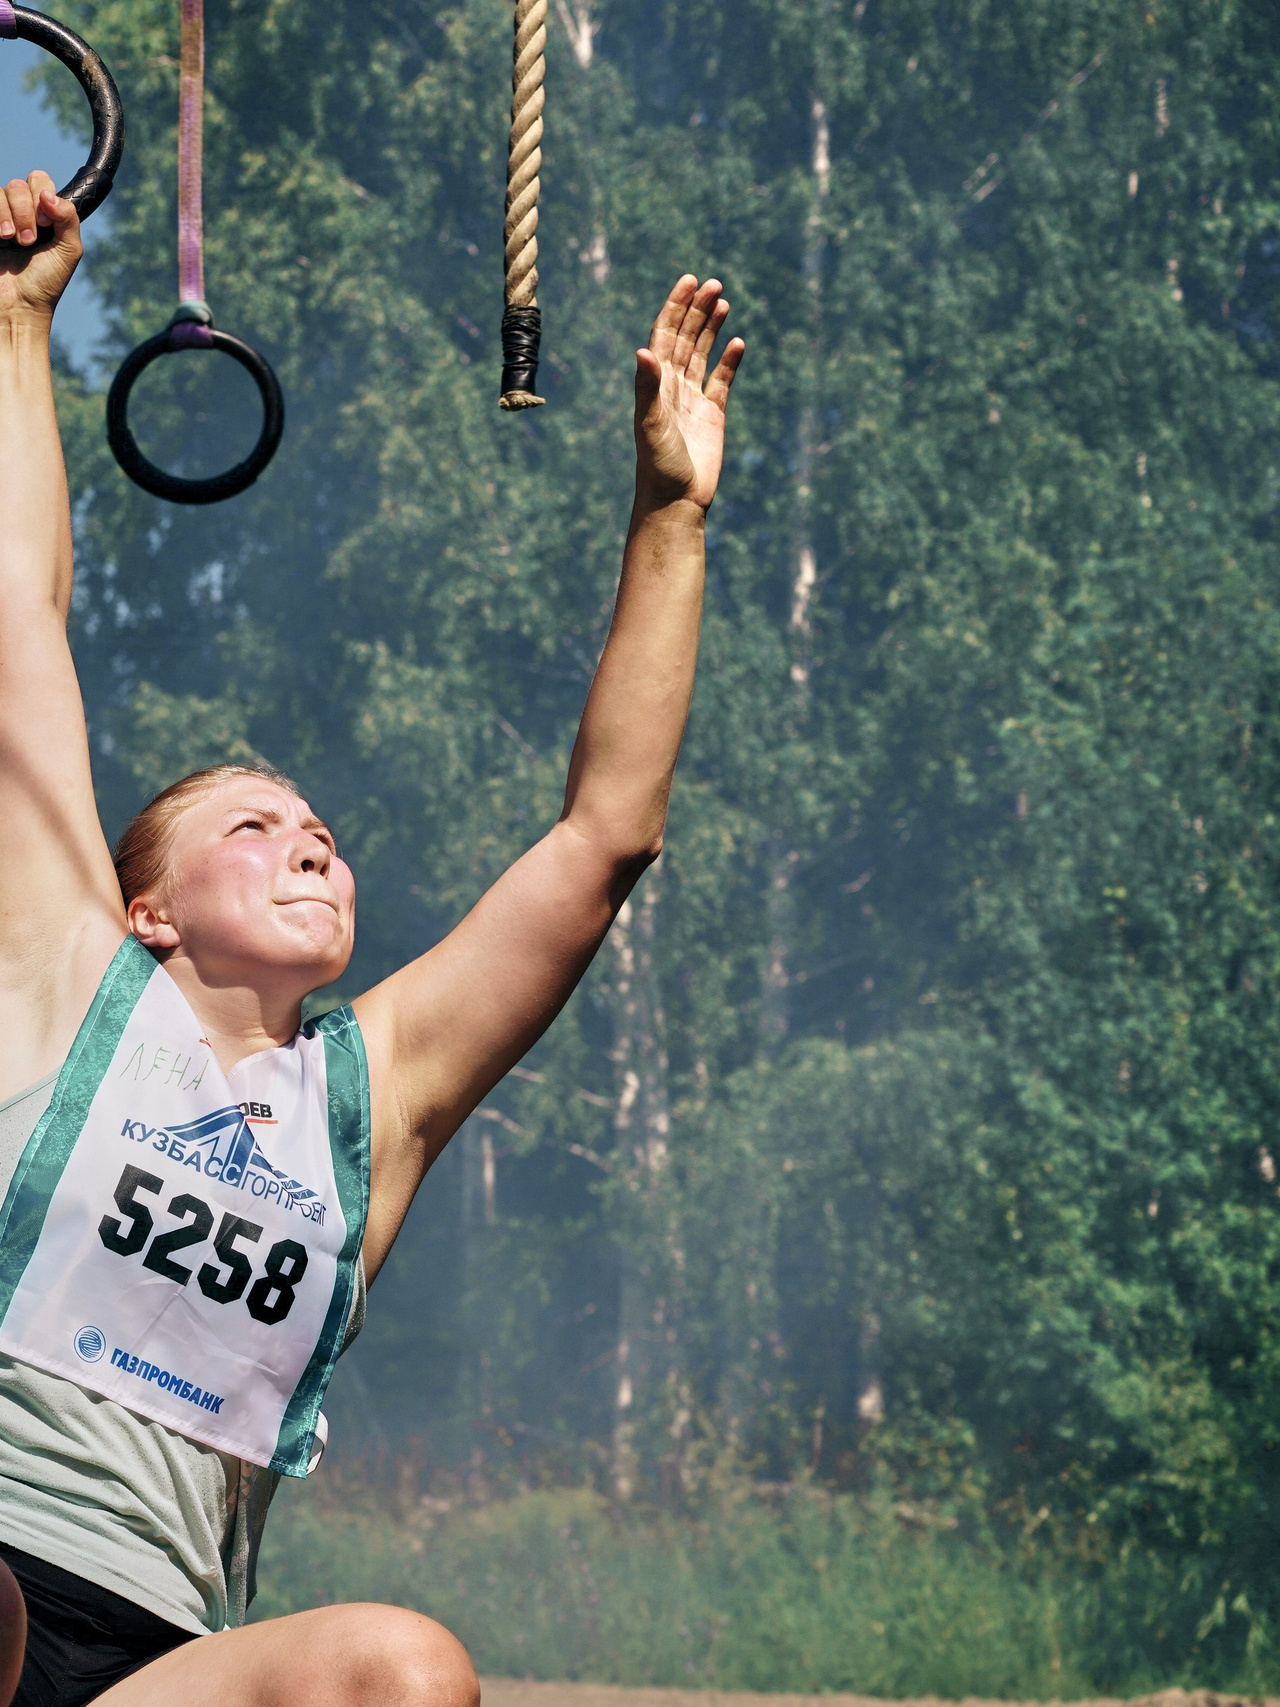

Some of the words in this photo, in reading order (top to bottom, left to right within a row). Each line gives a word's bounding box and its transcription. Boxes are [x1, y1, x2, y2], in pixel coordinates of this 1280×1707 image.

[119, 1043, 209, 1091] ЛЕНА
[98, 1163, 309, 1326] 5258
[110, 1348, 225, 1415] ГАЗПРОМБАНК
